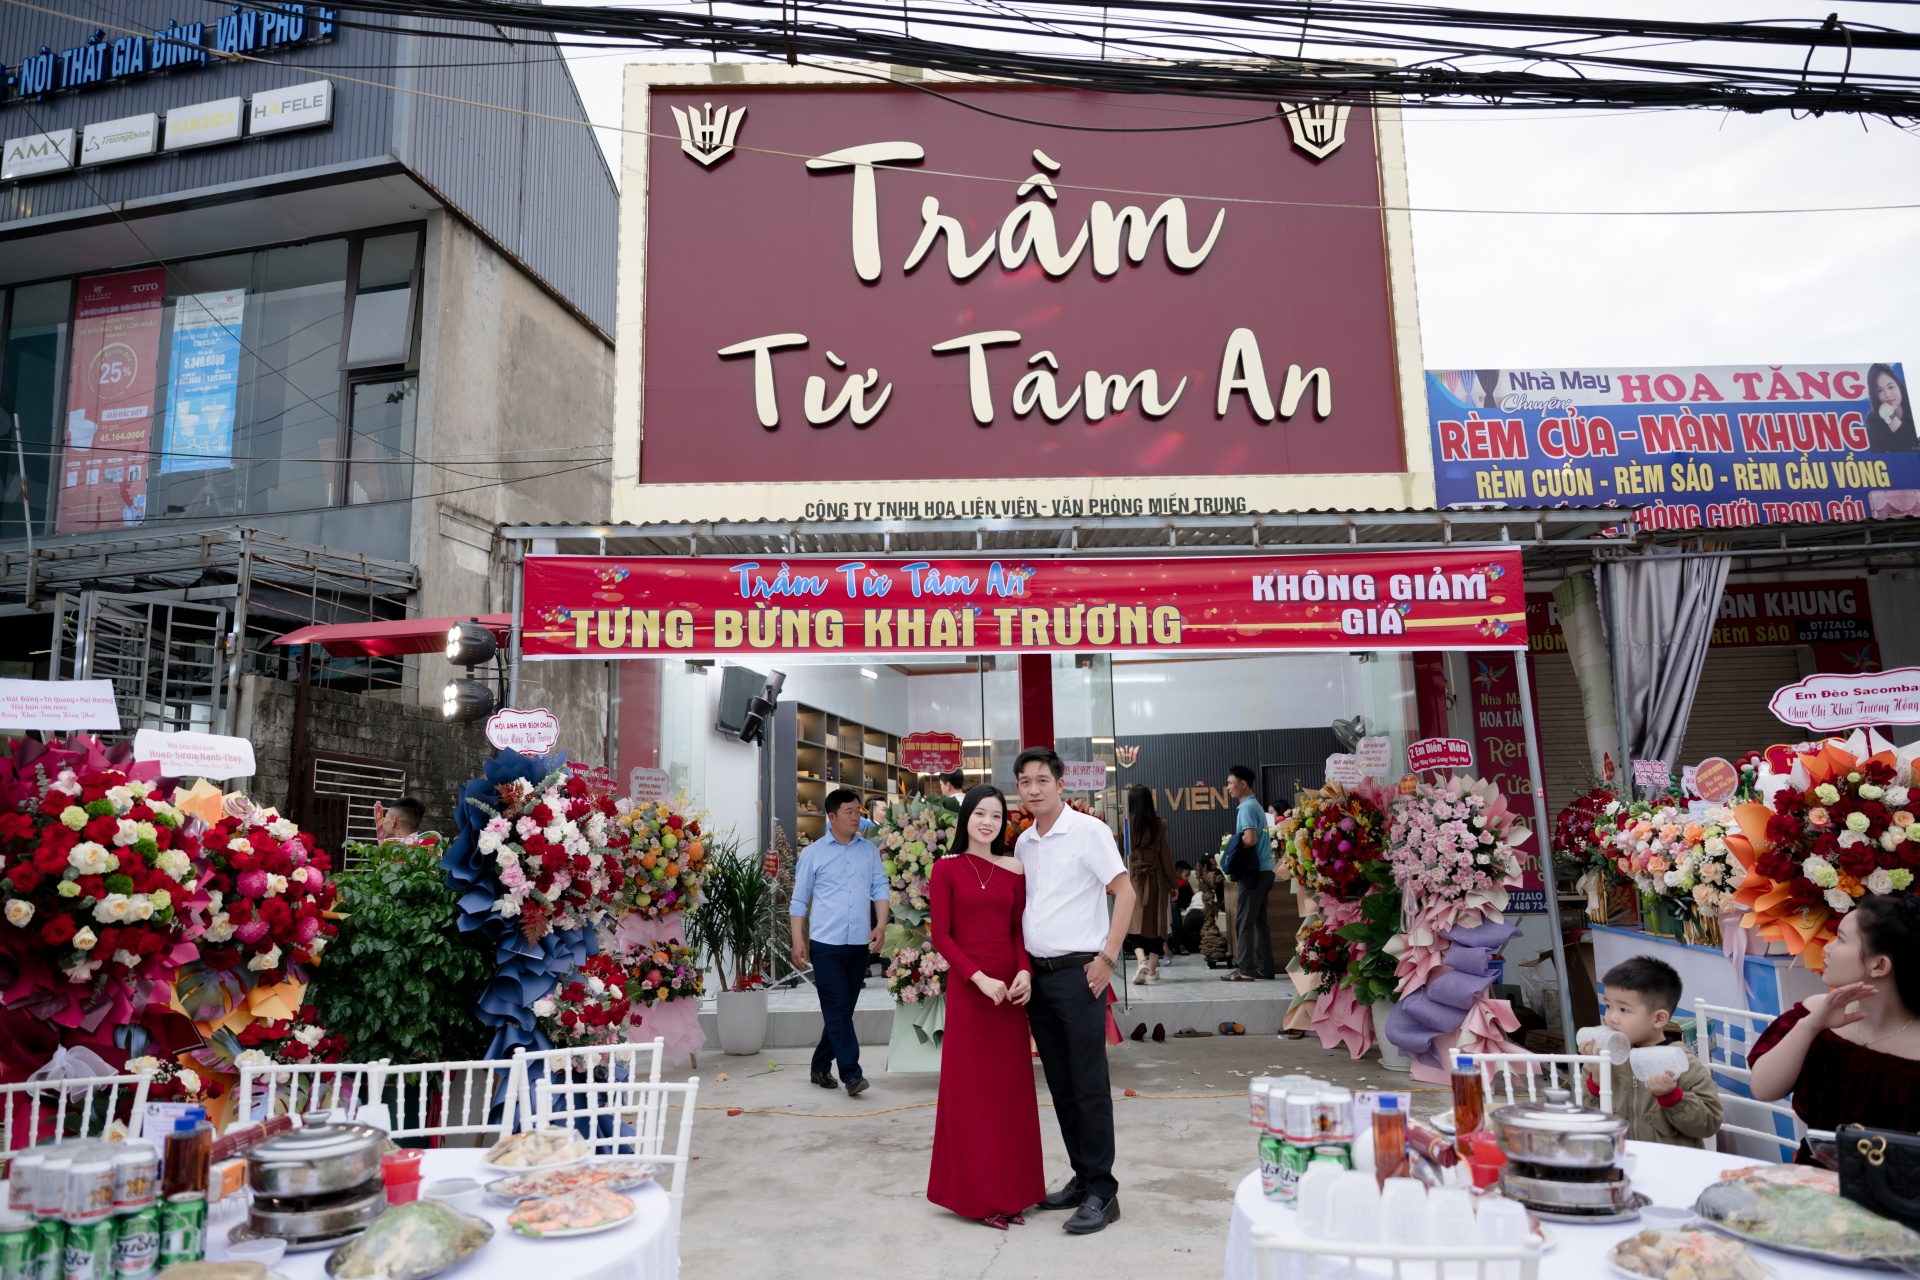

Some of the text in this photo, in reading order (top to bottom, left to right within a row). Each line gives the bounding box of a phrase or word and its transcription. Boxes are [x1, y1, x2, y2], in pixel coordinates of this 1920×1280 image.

[20, 46, 56, 100] NỘI
[61, 29, 107, 88] THẤT
[111, 36, 147, 78] GIA
[152, 19, 208, 67] ĐÌNH,
[216, 4, 258, 52] VĂN
[170, 111, 234, 135] TAICERA
[8, 137, 66, 162] AMY
[806, 142, 1225, 281] Trầm
[132, 282, 159, 293] TOTO
[718, 328, 1332, 427] Từ Tâm An
[1509, 366, 1866, 403] Nhà May HOA TĂNG
[1438, 411, 1528, 462] RÈM
[1538, 407, 1619, 459] CỬA
[1639, 406, 1735, 454] MÀN
[1739, 411, 1871, 453] KHUNG
[1475, 465, 1527, 500] RÈM
[1531, 458, 1594, 498] CUỐN
[1614, 461, 1664, 496] RÈM
[1671, 458, 1715, 493] SÁO
[1733, 457, 1782, 492] RÈM
[1786, 453, 1830, 490] CẦU
[1832, 450, 1892, 488] VỒNG
[805, 499, 851, 518] CÔNG
[853, 502, 871, 517] TY
[877, 501, 918, 517] TNHH
[925, 501, 956, 517] HOA
[961, 497, 996, 516] LIÊN
[1001, 497, 1037, 516] VIÊN
[1051, 495, 1084, 515] VĂN
[1089, 494, 1143, 514] PHÒNG
[1148, 493, 1190, 513] MIỀN
[1194, 496, 1246, 513] TRUNG
[729, 560, 1025, 598] Trầm Từ Tâm An
[1252, 566, 1487, 602] KHÔNG GIẢM
[1763, 588, 1857, 617] KHUNG
[569, 600, 1182, 649] TƯNG BỪNG KHAI TRƯƠNG
[1341, 603, 1405, 636] GIÁ
[1810, 620, 1856, 631] ĐT/ZALO
[1711, 622, 1790, 645] RÈM SÁO
[1800, 629, 1869, 641] 037 488 7346
[1480, 692, 1502, 706] Nhà
[1795, 692, 1817, 700] Em
[1853, 684, 1920, 696] Sacomba
[1479, 711, 1504, 728] HOA
[1830, 702, 1853, 717] Khai
[507, 722, 518, 730] ANH
[1410, 748, 1415, 759] 2
[1415, 746, 1425, 757] Em
[1164, 780, 1229, 812] VIÊN
[1514, 902, 1530, 911] 488
